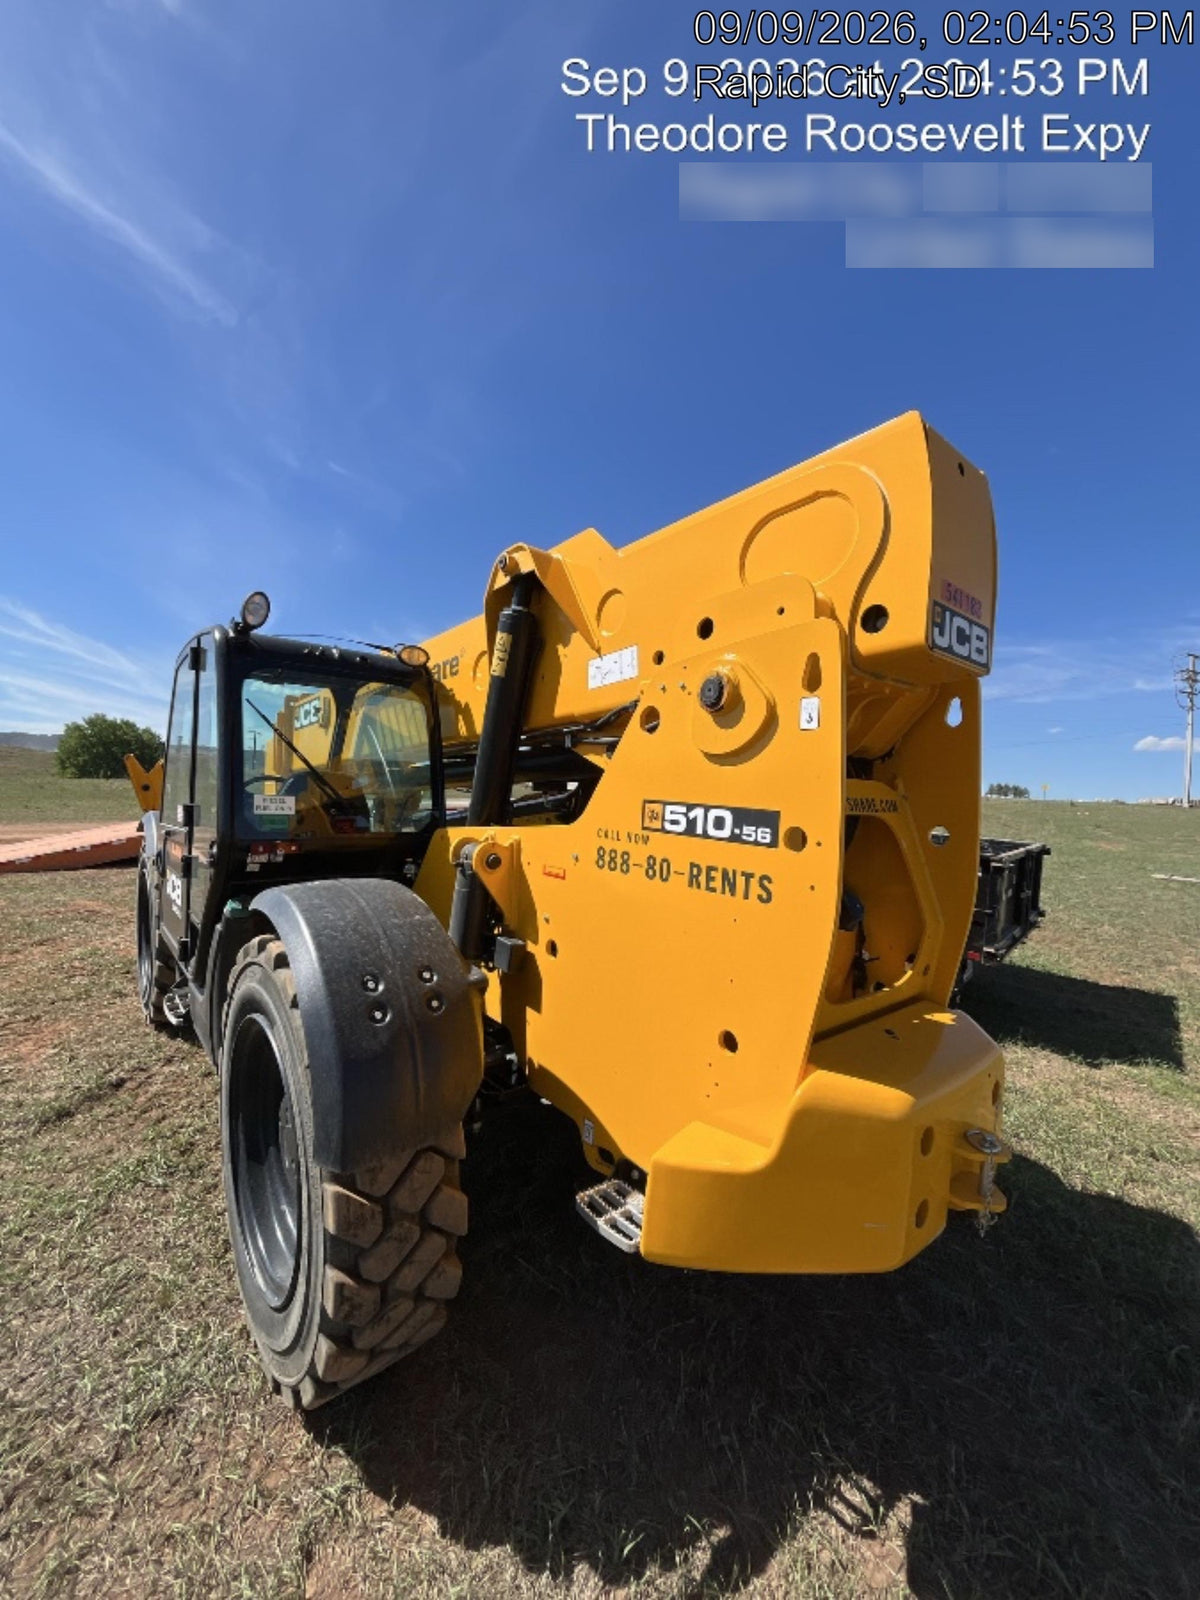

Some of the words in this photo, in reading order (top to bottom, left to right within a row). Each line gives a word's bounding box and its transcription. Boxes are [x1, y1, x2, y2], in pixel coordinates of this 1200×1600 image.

[933, 610, 988, 664] JCB
[597, 828, 621, 842] CALL
[626, 833, 650, 846] NOW
[595, 845, 773, 904] 888-80-RENTS
